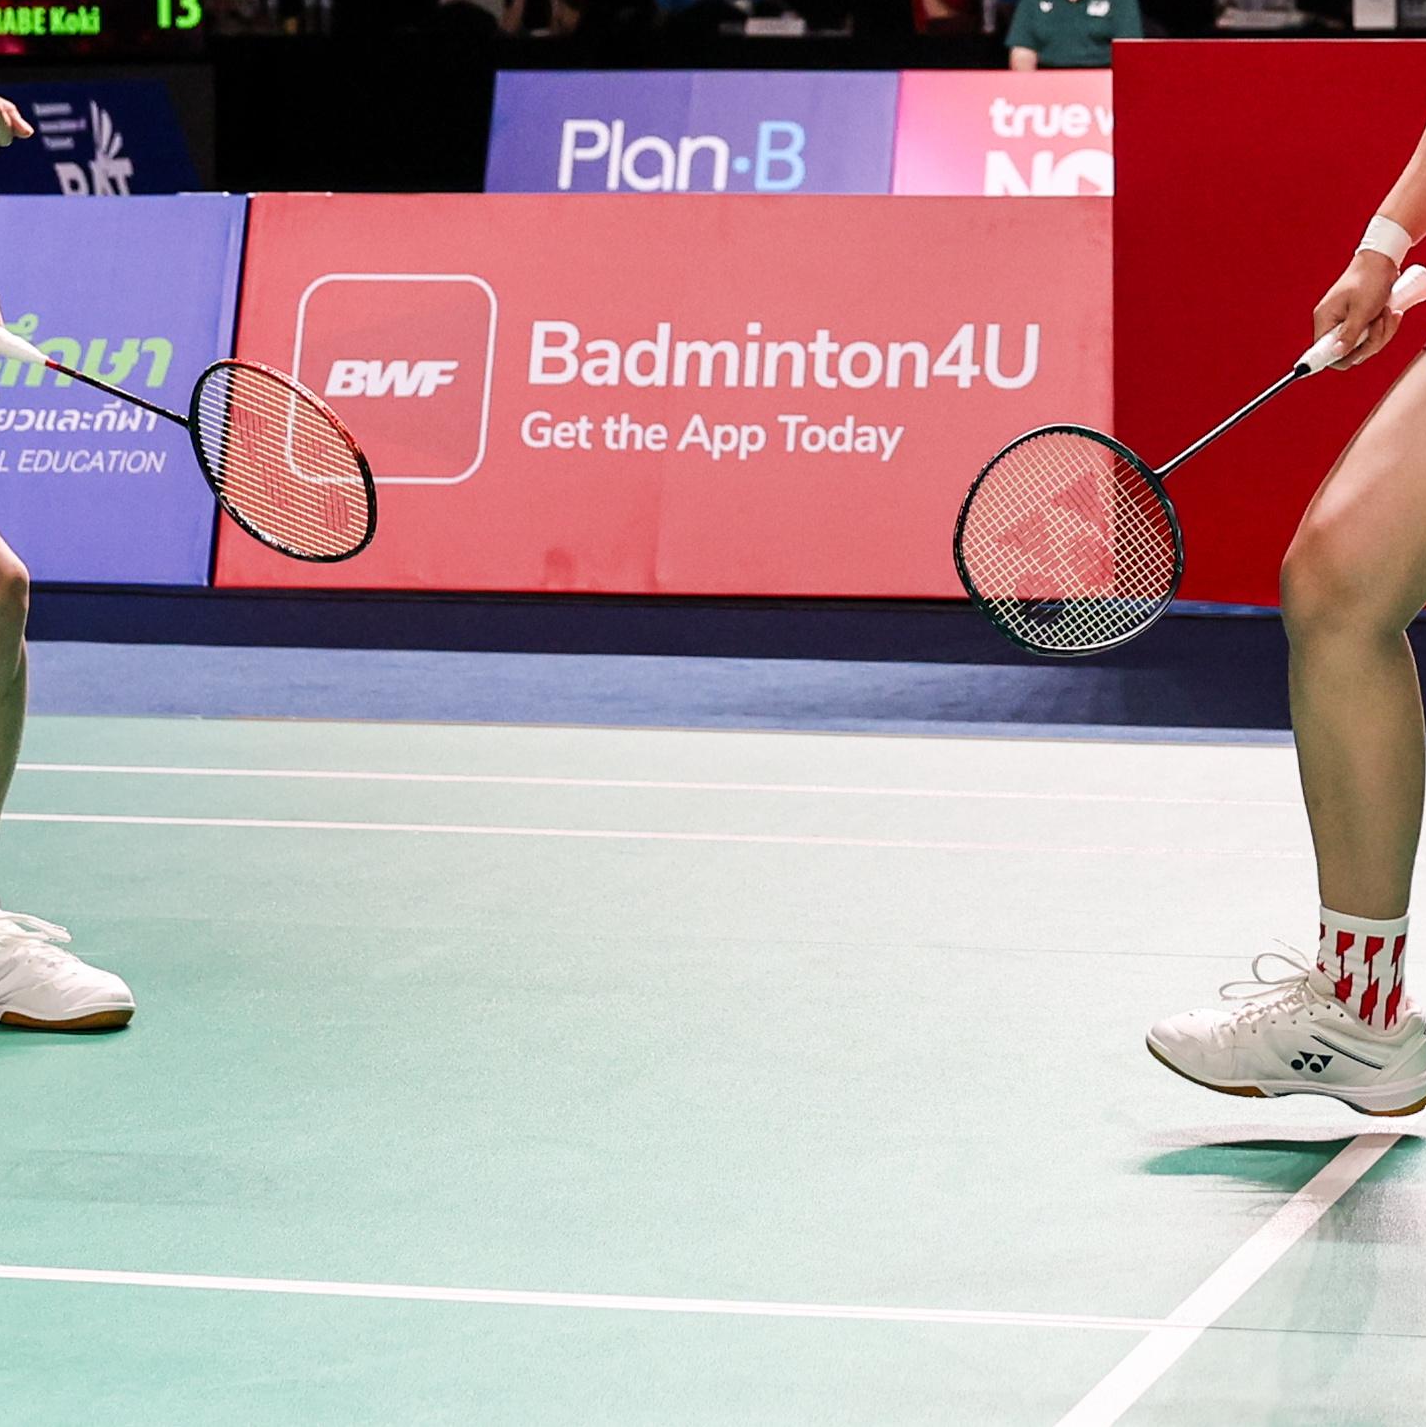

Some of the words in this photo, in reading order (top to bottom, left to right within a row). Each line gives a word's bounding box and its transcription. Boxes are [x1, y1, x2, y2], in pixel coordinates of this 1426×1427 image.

[49, 5, 101, 36] Koki
[988, 97, 1093, 139] true
[528, 320, 1041, 390] Badminton4U
[323, 359, 459, 398] BWF
[520, 411, 593, 451] Get
[602, 413, 669, 452] the
[676, 414, 767, 461] App
[777, 414, 905, 462] Today
[17, 448, 167, 474] EDUCATION
